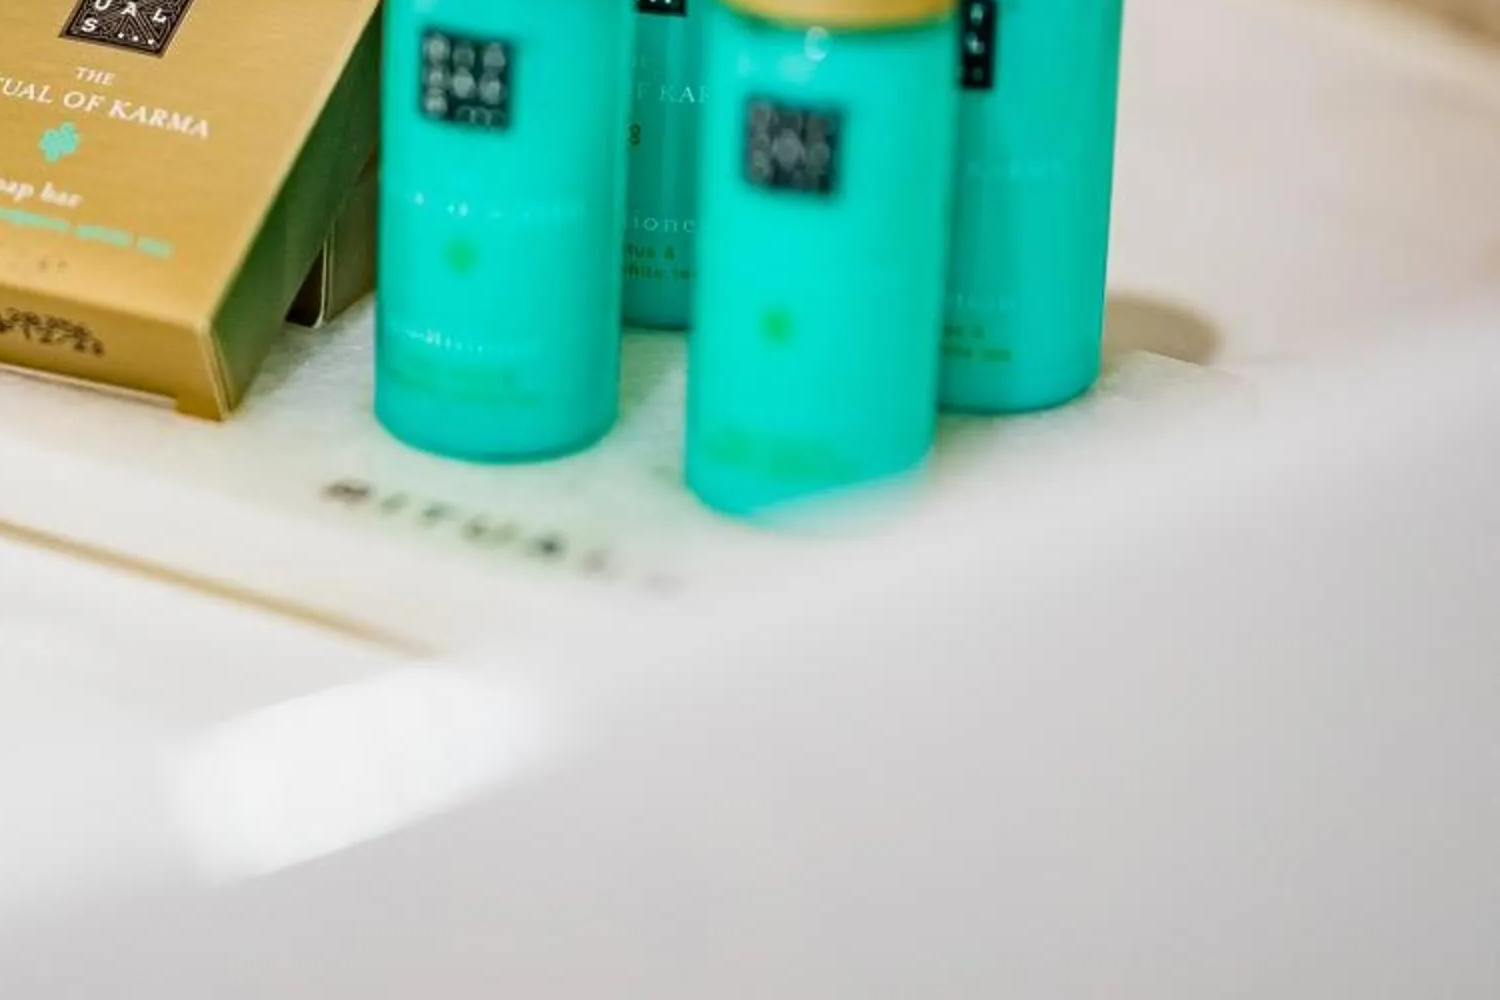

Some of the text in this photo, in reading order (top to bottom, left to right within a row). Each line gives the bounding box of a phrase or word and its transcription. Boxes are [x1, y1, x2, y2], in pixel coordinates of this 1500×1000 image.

[75, 66, 116, 86] THE
[63, 91, 105, 112] OF
[109, 98, 210, 139] KARMA
[40, 180, 84, 208] bar
